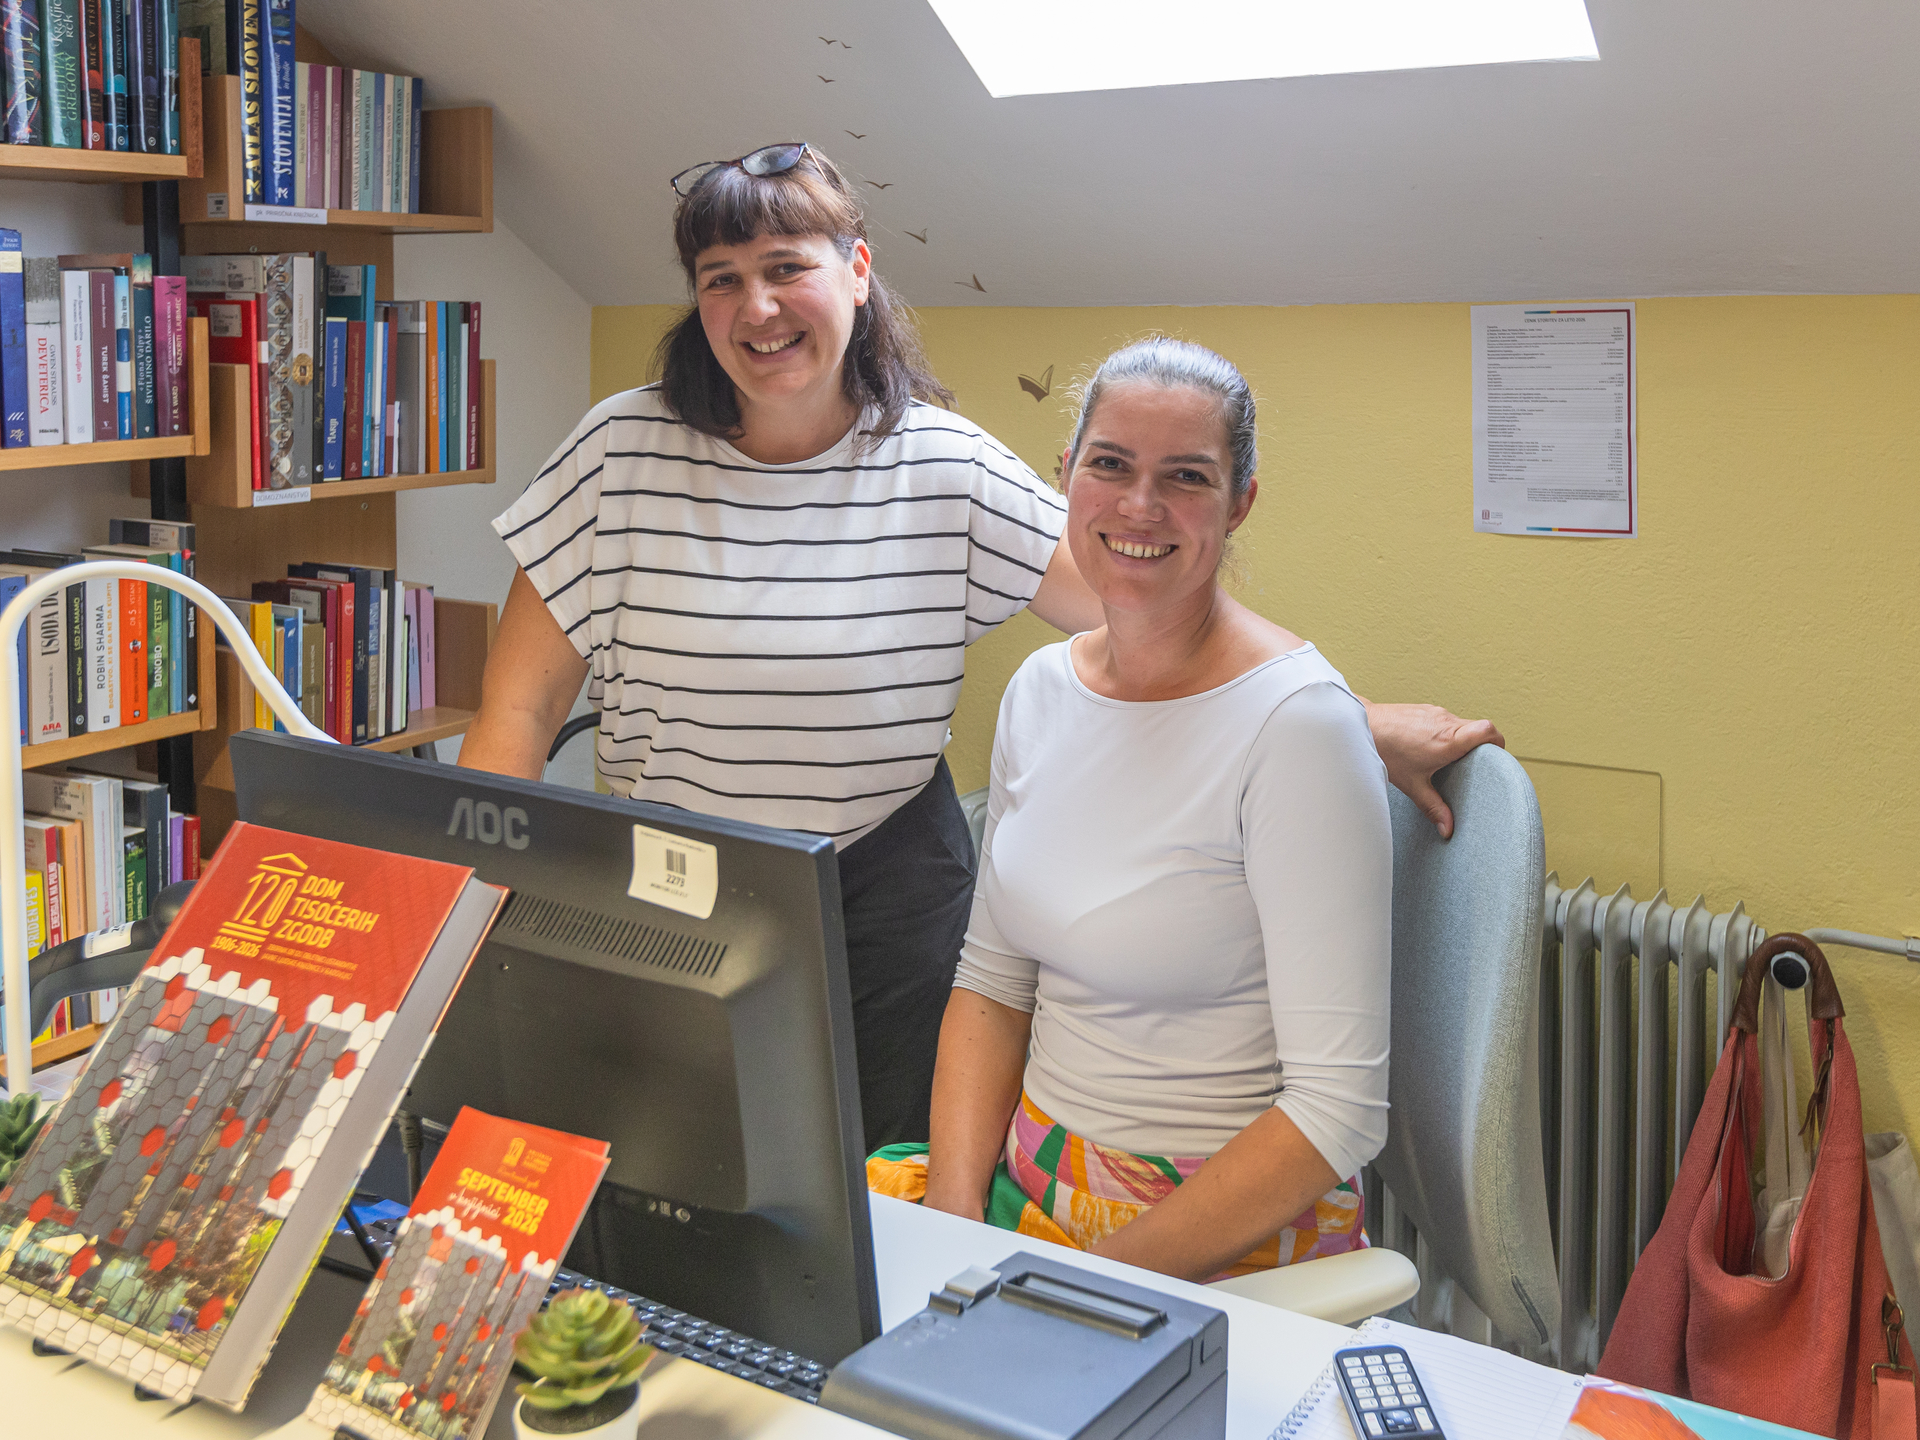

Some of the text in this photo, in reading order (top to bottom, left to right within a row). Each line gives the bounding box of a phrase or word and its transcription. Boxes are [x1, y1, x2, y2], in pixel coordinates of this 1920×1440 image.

[88, 42, 97, 67] MEČ
[52, 51, 67, 119] PHILIPPA
[64, 52, 78, 121] GREGORY
[244, 96, 261, 173] ATLAS
[273, 95, 293, 175] SLOVENIJA
[137, 334, 146, 359] Valpy
[144, 316, 153, 404] ŠIVILJINO DARILO
[273, 264, 291, 452] Brezjanski zbornik 2000
[37, 337, 50, 414] DEVETERICA
[101, 345, 111, 403] TUREK ŠAHIST
[41, 611, 60, 656] USODA
[74, 625, 81, 635] ZA
[106, 609, 113, 619] DA
[129, 616, 136, 626] OB
[153, 598, 163, 633] ATEIST
[95, 604, 106, 689] ROBIN SHARMA
[107, 633, 113, 643] GA
[154, 645, 163, 688] BONOBO
[42, 722, 62, 731] ARA
[447, 797, 531, 851] AOC
[234, 872, 298, 928] 120
[300, 874, 345, 900] DOM
[25, 886, 40, 948] PRIDEN PES
[273, 919, 336, 949] ZGODB
[290, 896, 380, 933] TISOČERIH
[210, 935, 262, 958] 1906-2026
[456, 1167, 549, 1218] SEPTEMBER
[501, 1205, 542, 1237] 2026
